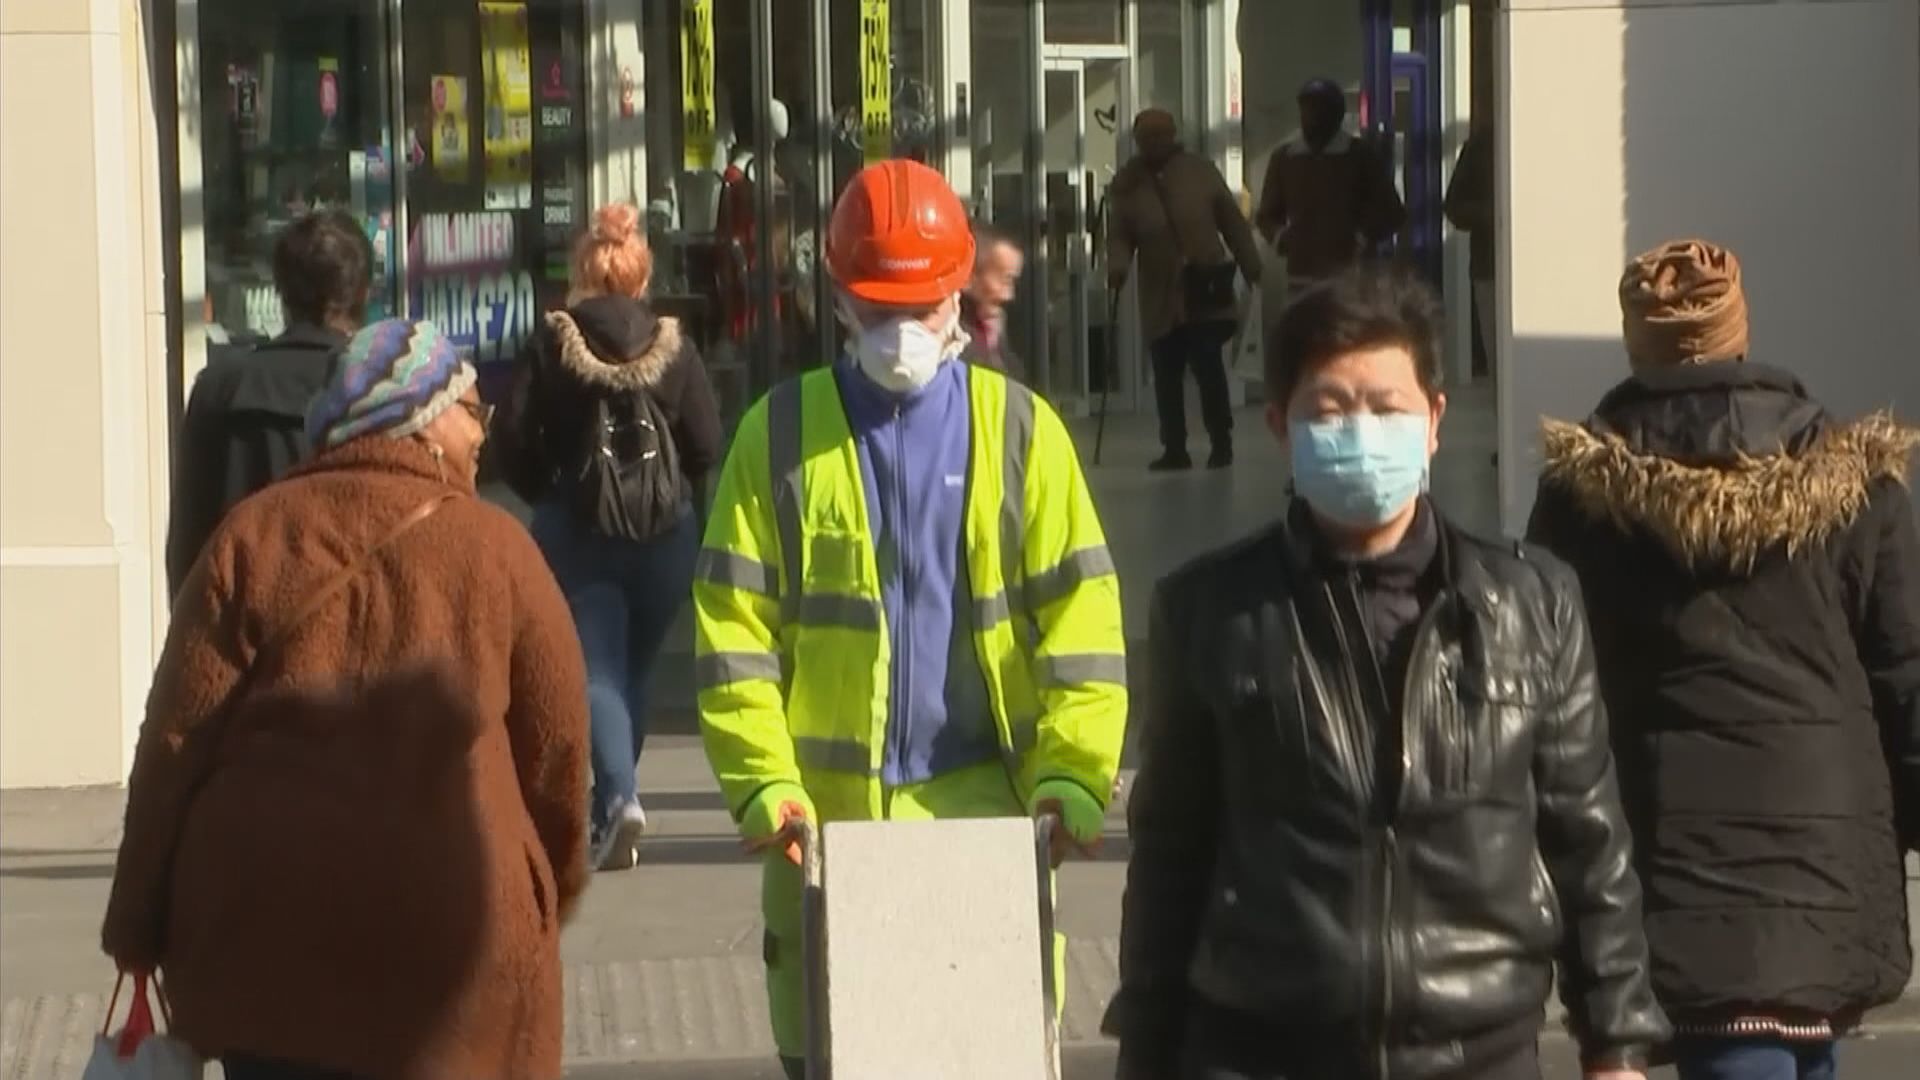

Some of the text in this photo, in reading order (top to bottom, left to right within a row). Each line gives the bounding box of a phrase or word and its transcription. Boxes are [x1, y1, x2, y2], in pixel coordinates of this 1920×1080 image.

[541, 105, 571, 126] BEAUTY
[866, 111, 888, 137] OFF
[543, 205, 570, 223] DRINKS
[422, 211, 514, 266] UNLIMITED
[422, 270, 535, 362] DATA £20
